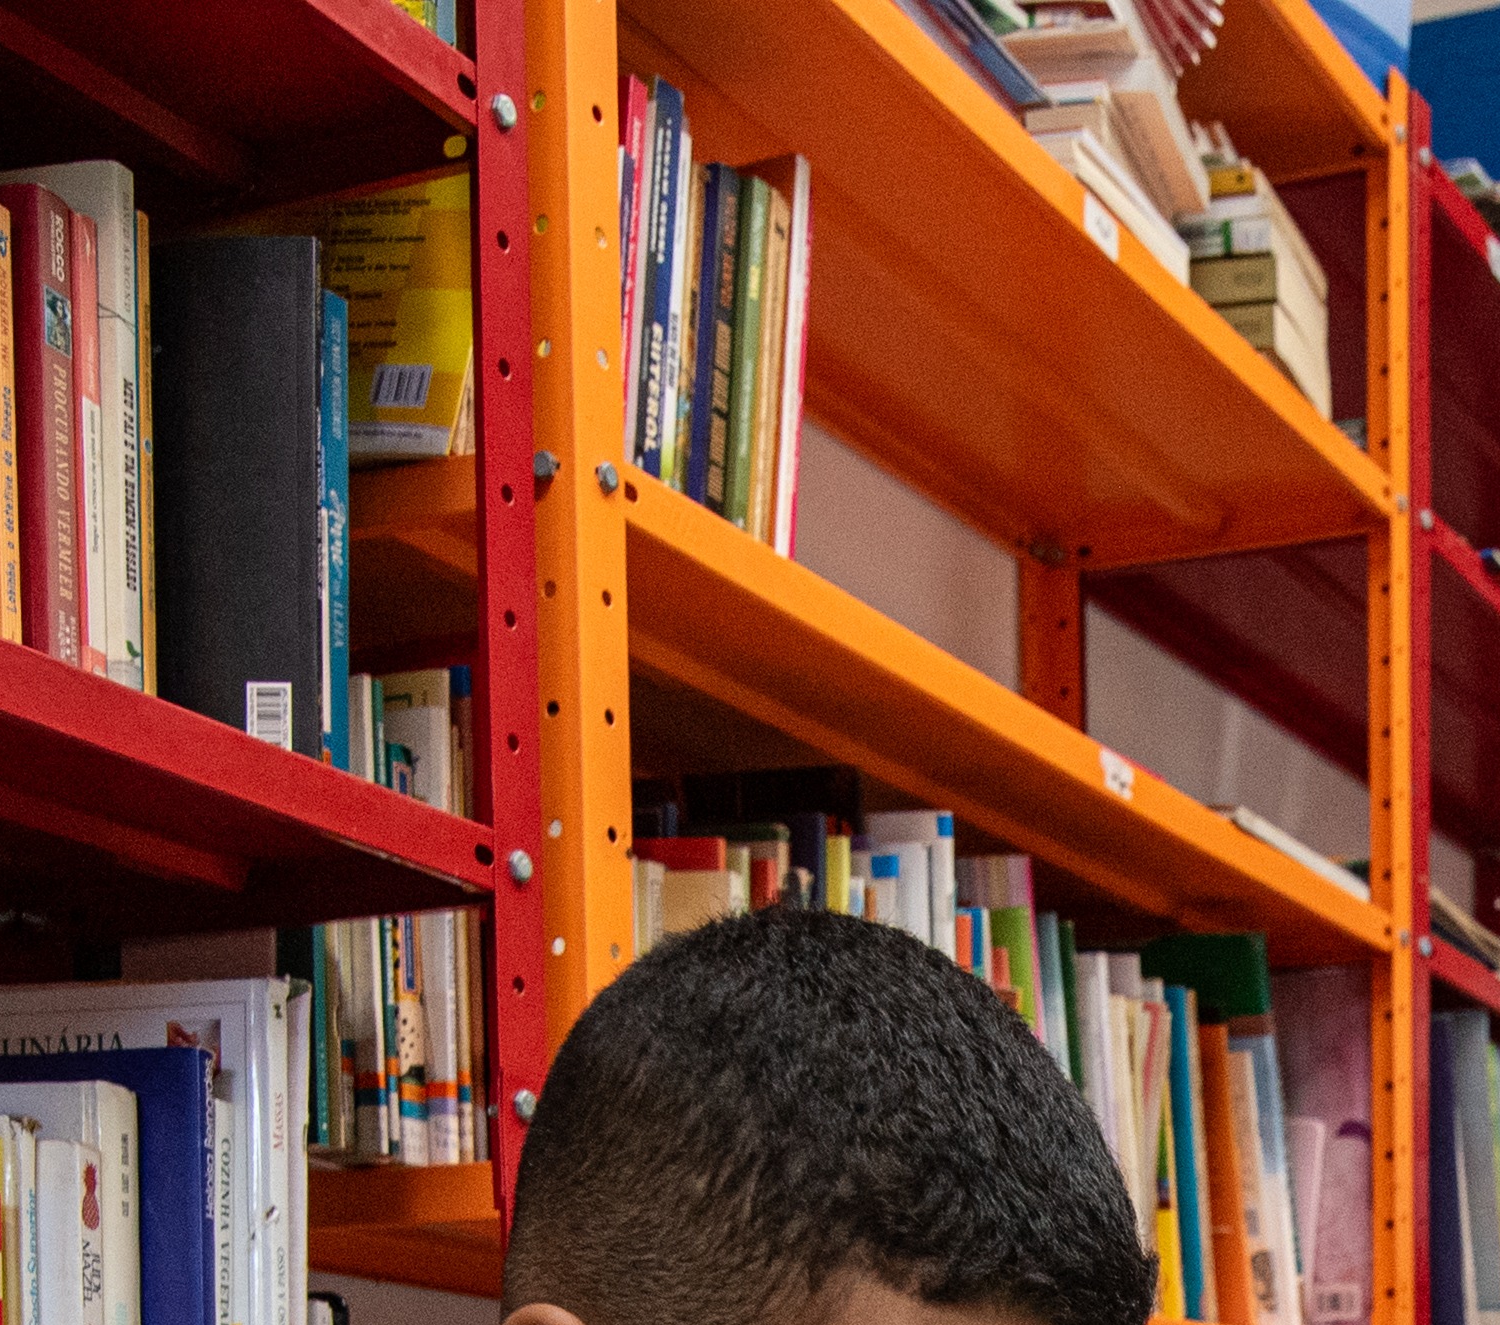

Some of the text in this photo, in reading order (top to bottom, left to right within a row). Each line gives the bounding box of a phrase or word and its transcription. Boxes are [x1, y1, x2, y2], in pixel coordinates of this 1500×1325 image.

[55, 215, 65, 281] ROCCO
[52, 363, 70, 501] PROCURANDO
[123, 378, 135, 475] MEU PAI UM
[643, 323, 663, 451] FUTEBOL
[57, 508, 73, 601] VERMEER
[203, 1056, 216, 1219] Heloisa Bernardes
[219, 1137, 232, 1232] COZINHA
[25, 1188, 39, 1256] Superior
[278, 1247, 287, 1289] PASSO
[82, 1239, 93, 1308] MAZEL
